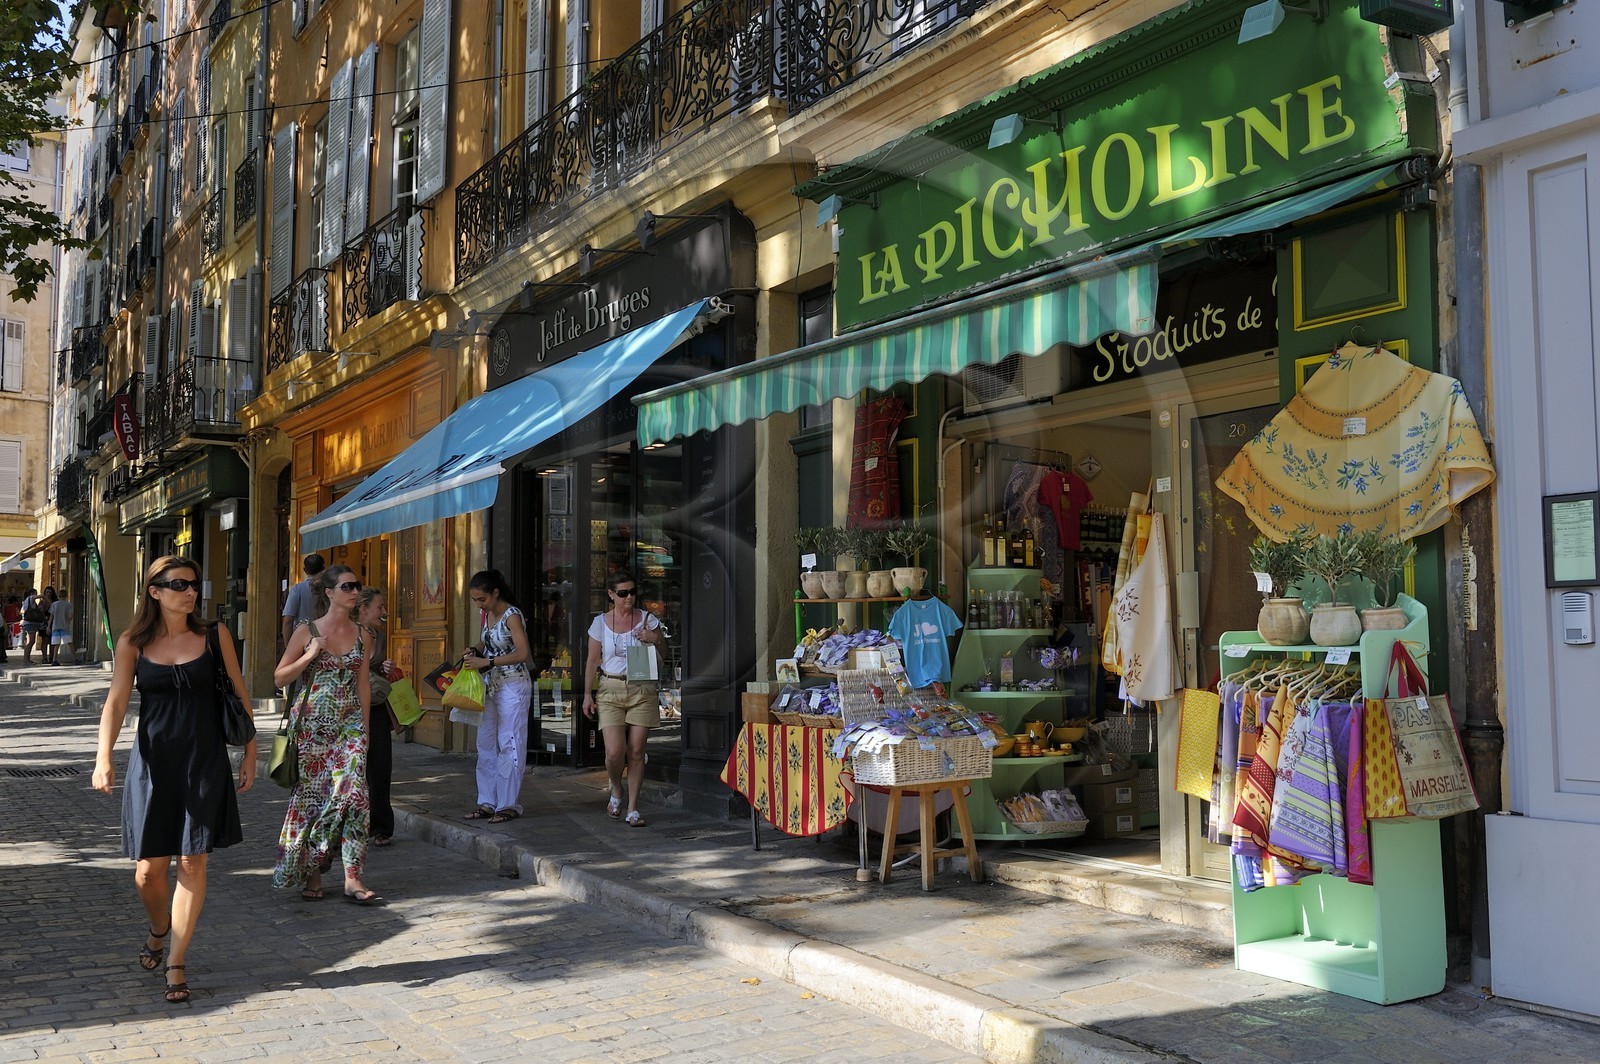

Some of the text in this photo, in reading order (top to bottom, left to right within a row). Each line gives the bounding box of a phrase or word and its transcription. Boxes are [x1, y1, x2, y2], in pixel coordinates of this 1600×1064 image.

[858, 75, 1356, 305] LA PICHOLINE
[537, 307, 566, 362] Jeff
[568, 317, 581, 340] de
[583, 287, 650, 334] Bruges
[1237, 296, 1262, 332] de
[120, 403, 135, 453] TABAC
[1228, 423, 1247, 438] 20
[1433, 749, 1441, 760] DE
[1409, 773, 1467, 798] MARSEILLE
